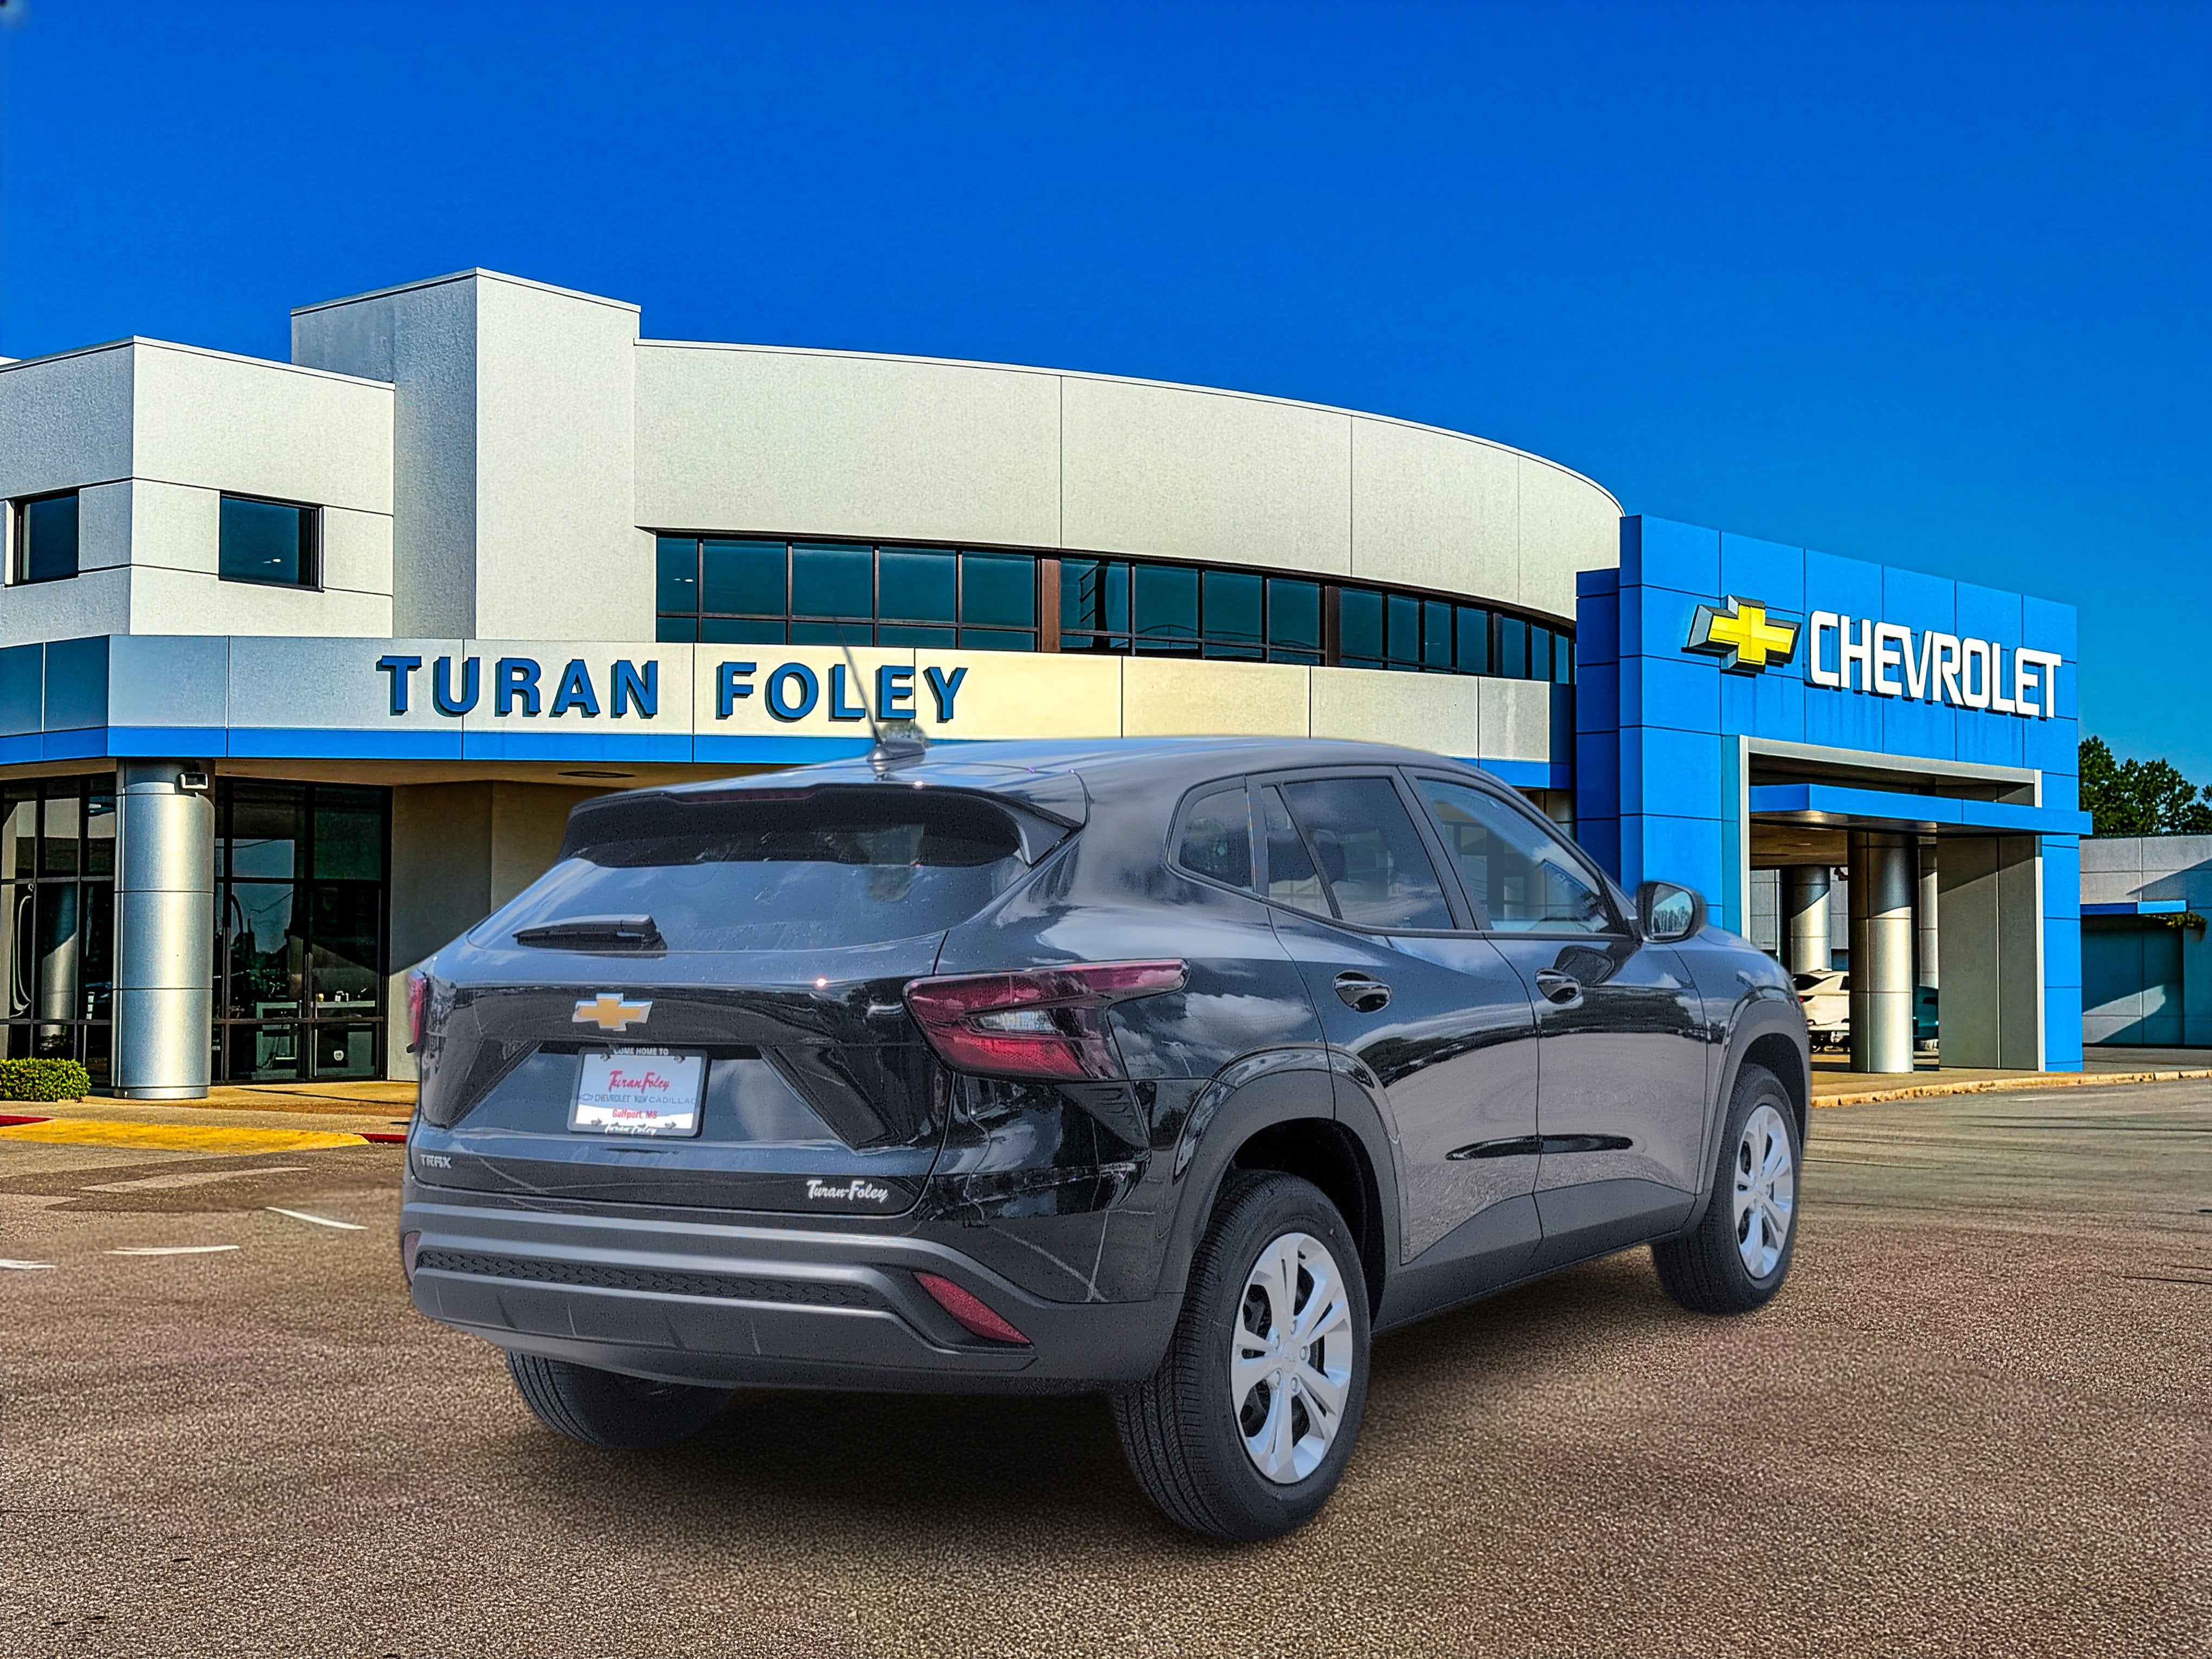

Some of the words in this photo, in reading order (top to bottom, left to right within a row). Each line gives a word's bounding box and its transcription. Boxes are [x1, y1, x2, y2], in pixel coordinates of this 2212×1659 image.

[1810, 609, 2062, 719] CHEVROLET
[376, 655, 658, 719] TURAN
[716, 661, 969, 723] FOLEY
[646, 1110, 658, 1119] MS
[420, 1154, 452, 1168] TRAX
[806, 1180, 890, 1204] Turan-Foley
